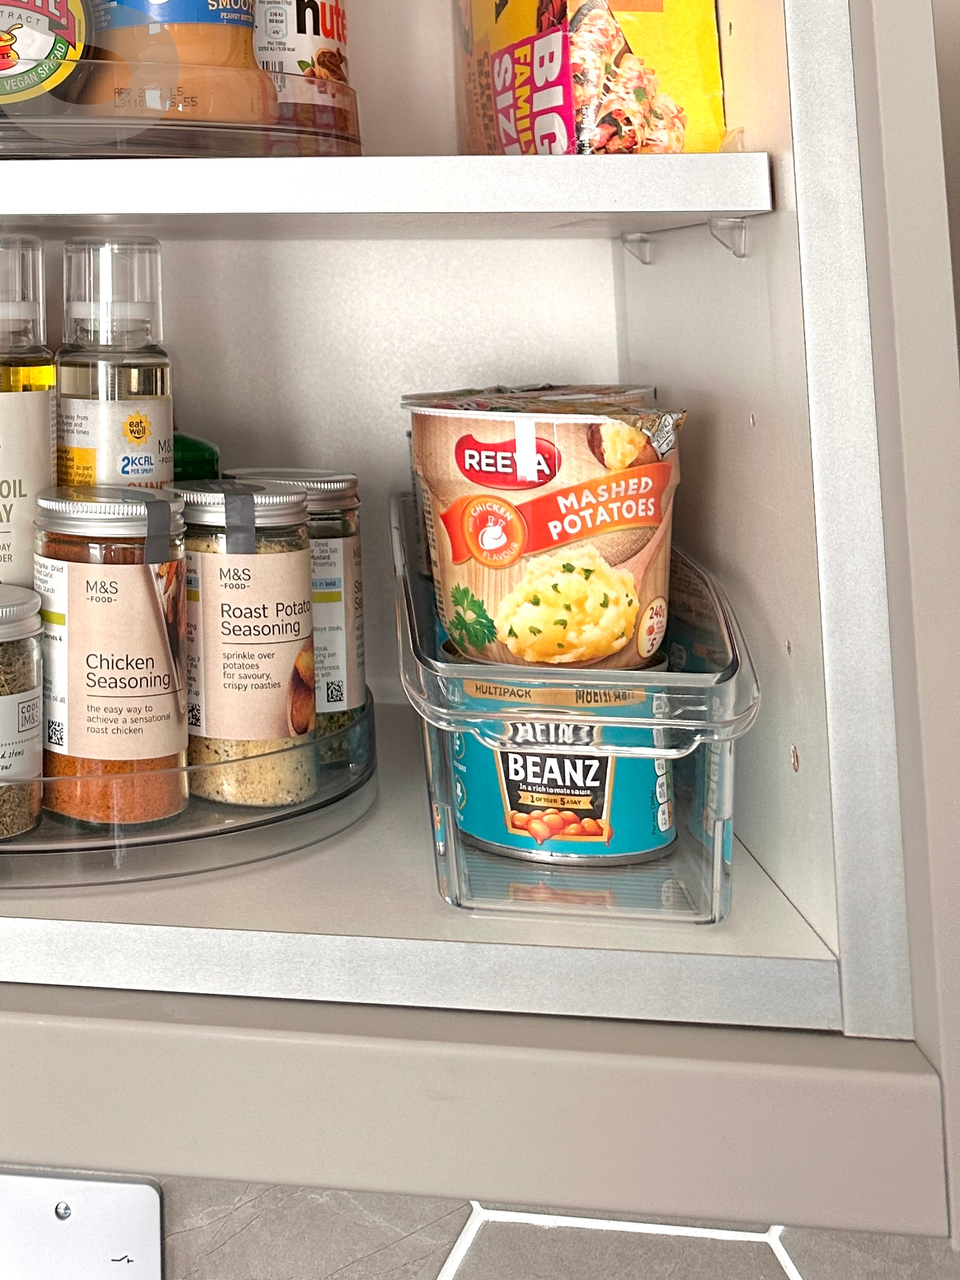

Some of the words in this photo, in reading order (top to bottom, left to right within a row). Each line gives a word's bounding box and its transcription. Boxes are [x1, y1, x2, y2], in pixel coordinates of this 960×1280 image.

[3, 73, 39, 91] VEGAN
[113, 87, 132, 97] APR
[532, 31, 568, 155] BIG
[128, 419, 143, 428] eat
[129, 426, 146, 436] well
[463, 449, 550, 475] REEA
[556, 476, 653, 514] MASHED
[470, 502, 514, 521] CHICKEN
[547, 497, 655, 540] POTATOES
[482, 540, 519, 561] FLAVOUR
[219, 568, 251, 581] M&S
[85, 580, 119, 595] M&S
[221, 603, 268, 619] Roast
[276, 599, 311, 618] Potato
[221, 620, 300, 637] Seasoning
[85, 653, 155, 670] Chicken
[223, 651, 255, 661] sprinkle
[258, 652, 275, 660] over
[223, 662, 260, 672] potatoes
[86, 672, 171, 690] Seasoning
[223, 671, 236, 680] for
[238, 672, 271, 681] savoury,
[223, 681, 248, 691] crispy
[251, 681, 282, 690] roasties
[475, 683, 532, 699] MULTIPACK
[86, 704, 100, 713] the
[103, 706, 123, 715] easy
[126, 706, 142, 715] way
[144, 704, 153, 713] to
[86, 715, 120, 724] achieve
[129, 712, 171, 724] sensational
[86, 726, 108, 734] roast
[111, 726, 144, 735] chicken
[8, 748, 25, 760] stews
[507, 752, 601, 787] BEANZ
[519, 783, 527, 791] In
[532, 785, 546, 793] rich
[546, 786, 570, 795] tomato
